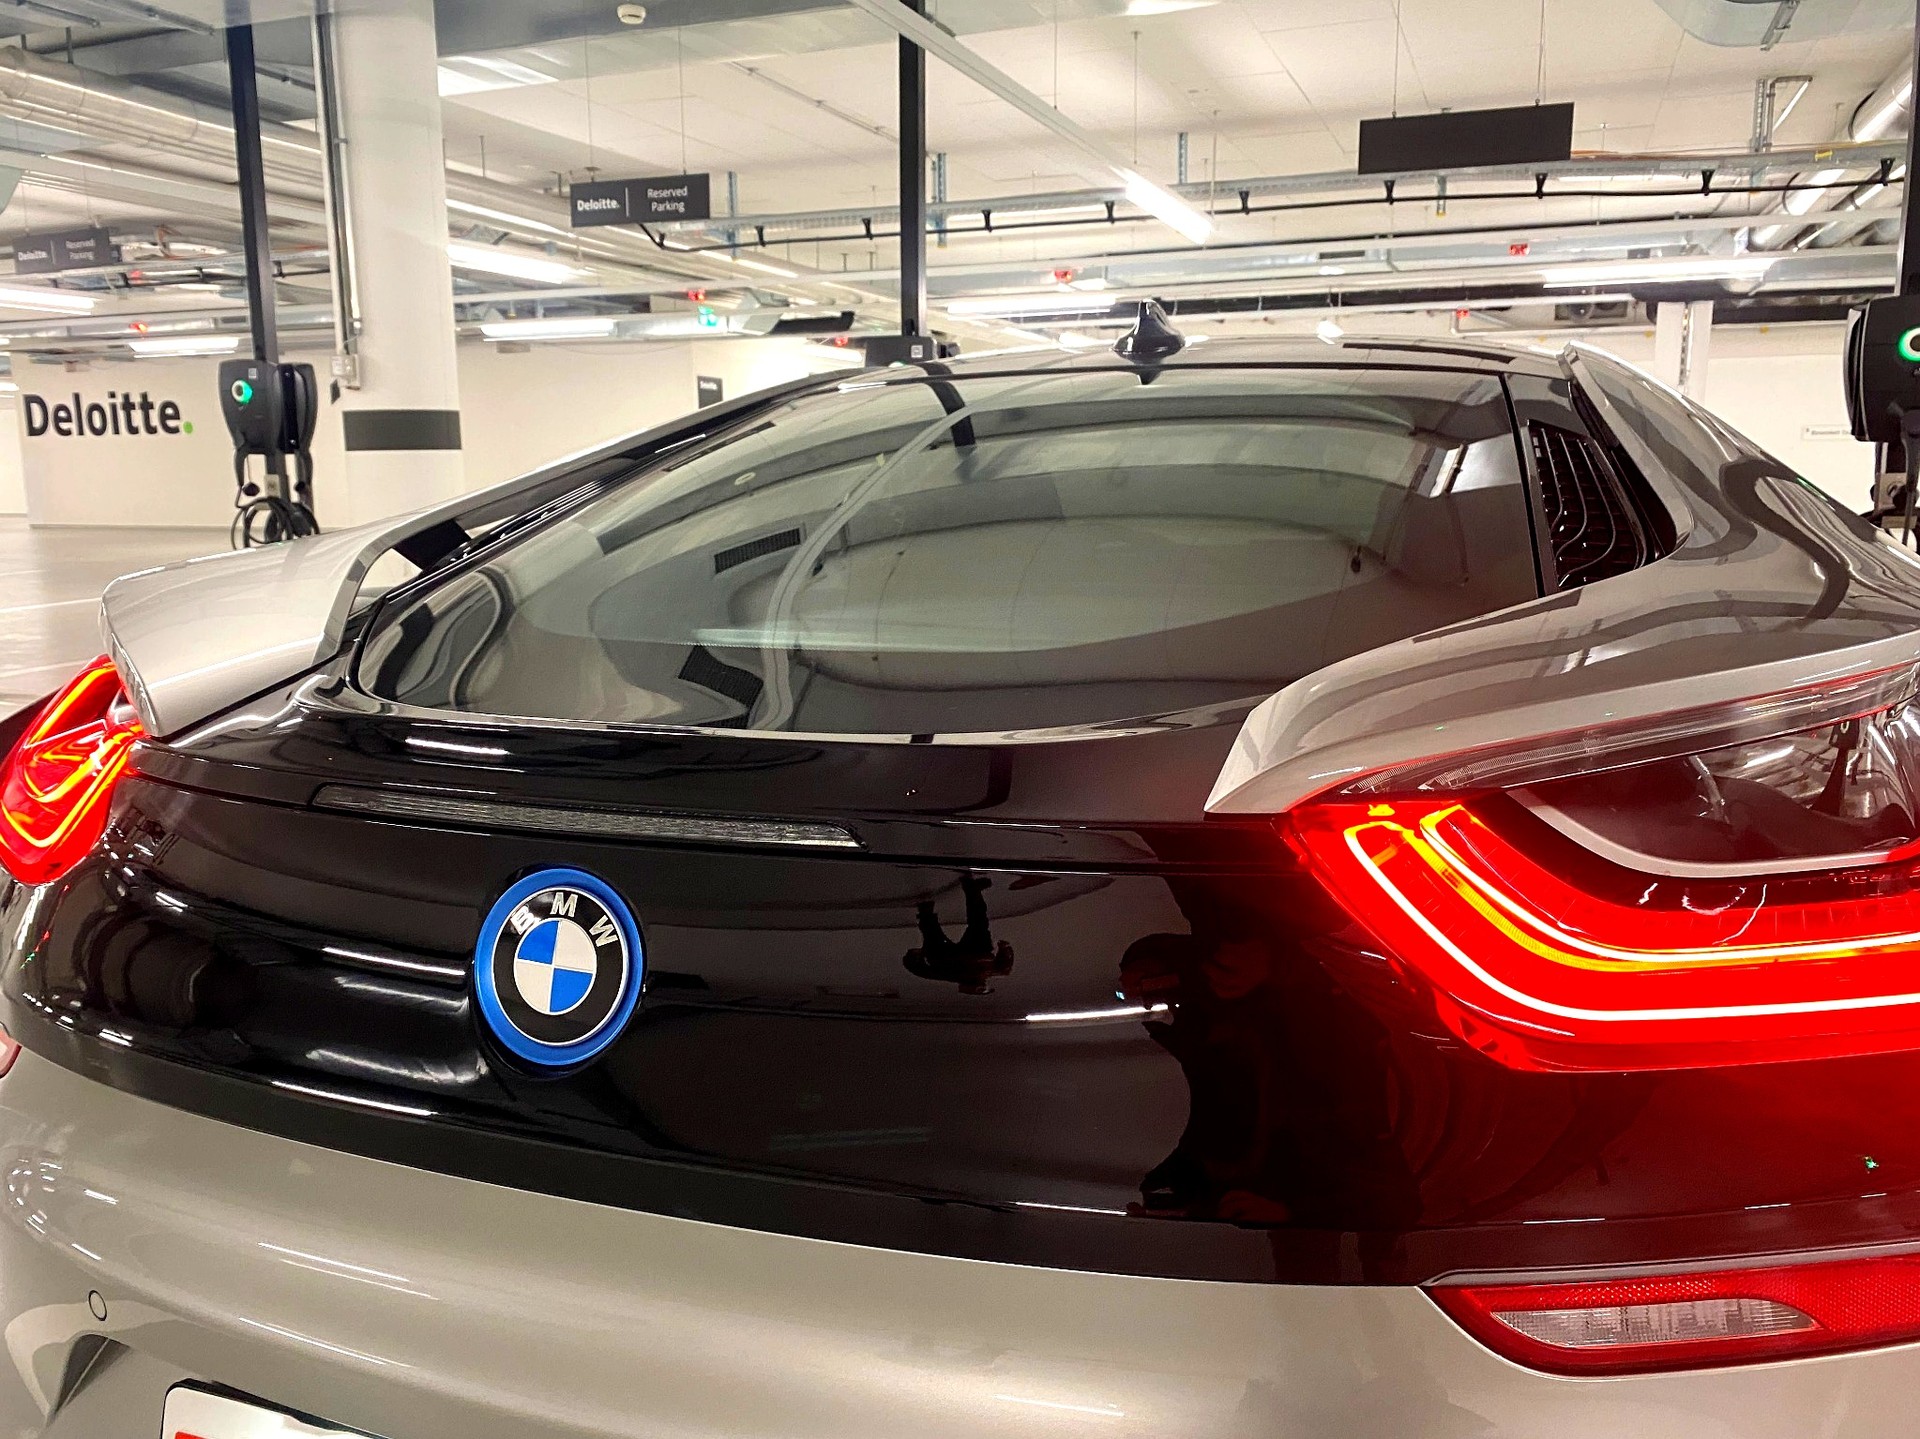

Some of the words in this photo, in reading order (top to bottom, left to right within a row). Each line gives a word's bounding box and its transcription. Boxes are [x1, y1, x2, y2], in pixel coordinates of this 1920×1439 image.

[647, 186, 688, 198] Reserved
[651, 201, 685, 213] Parking
[23, 391, 193, 437] Deloitte.
[509, 892, 619, 947] BMW
